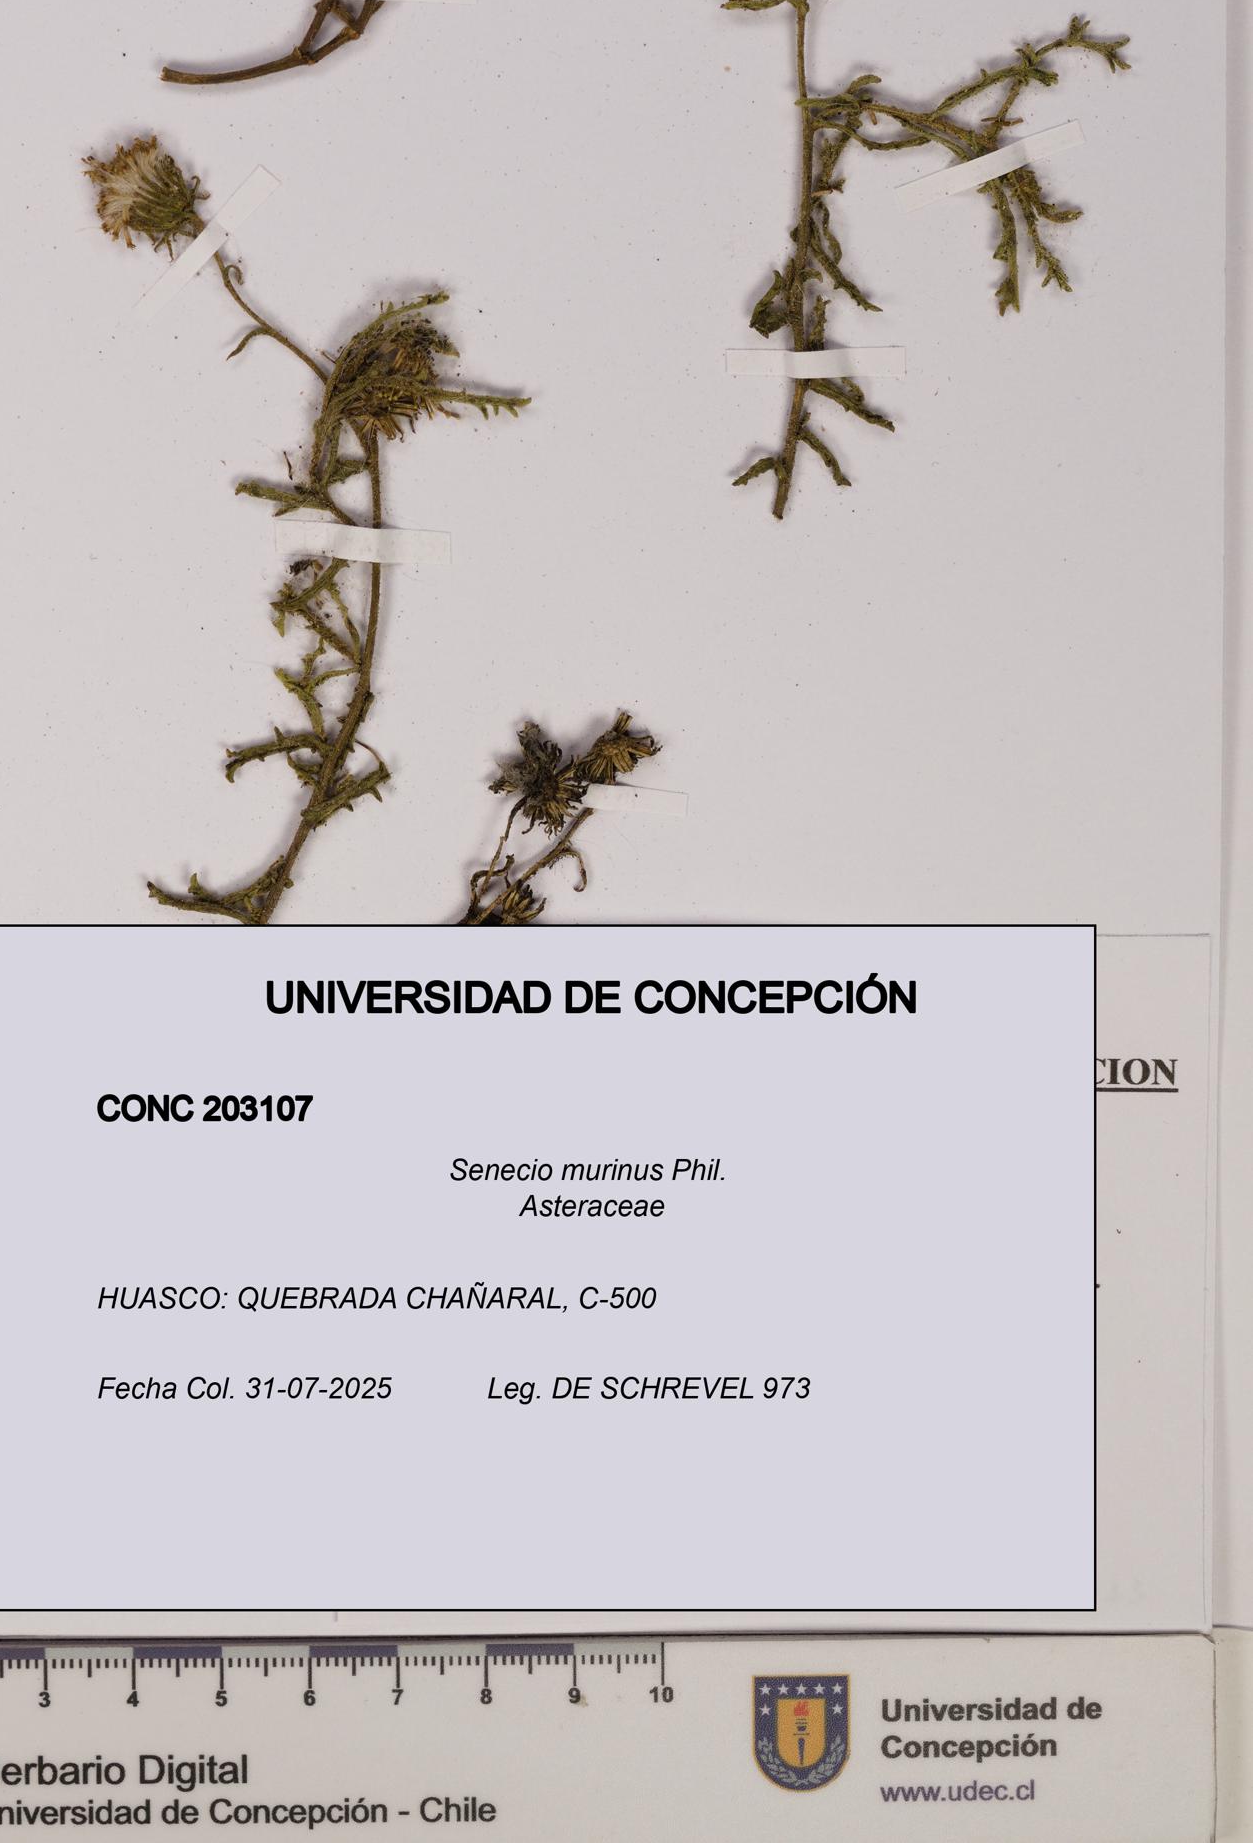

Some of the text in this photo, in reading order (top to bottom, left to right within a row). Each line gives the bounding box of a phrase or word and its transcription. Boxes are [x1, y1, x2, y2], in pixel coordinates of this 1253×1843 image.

[38, 1690, 51, 1708] 3
[126, 1690, 140, 1708] 4
[215, 1689, 228, 1707] 5
[303, 1689, 316, 1707] 6
[391, 1688, 404, 1706] 7
[480, 1687, 493, 1705] 8
[568, 1686, 581, 1704] 9
[649, 1685, 674, 1703] 10
[881, 1696, 1103, 1723] Universidad de
[880, 1732, 1057, 1764] Concepción
[139, 1754, 248, 1793] Digital
[879, 1778, 1035, 1803] www.udec.cl
[161, 1798, 200, 1825] de
[209, 1797, 388, 1829] Concepción
[419, 1796, 497, 1823] Chile
